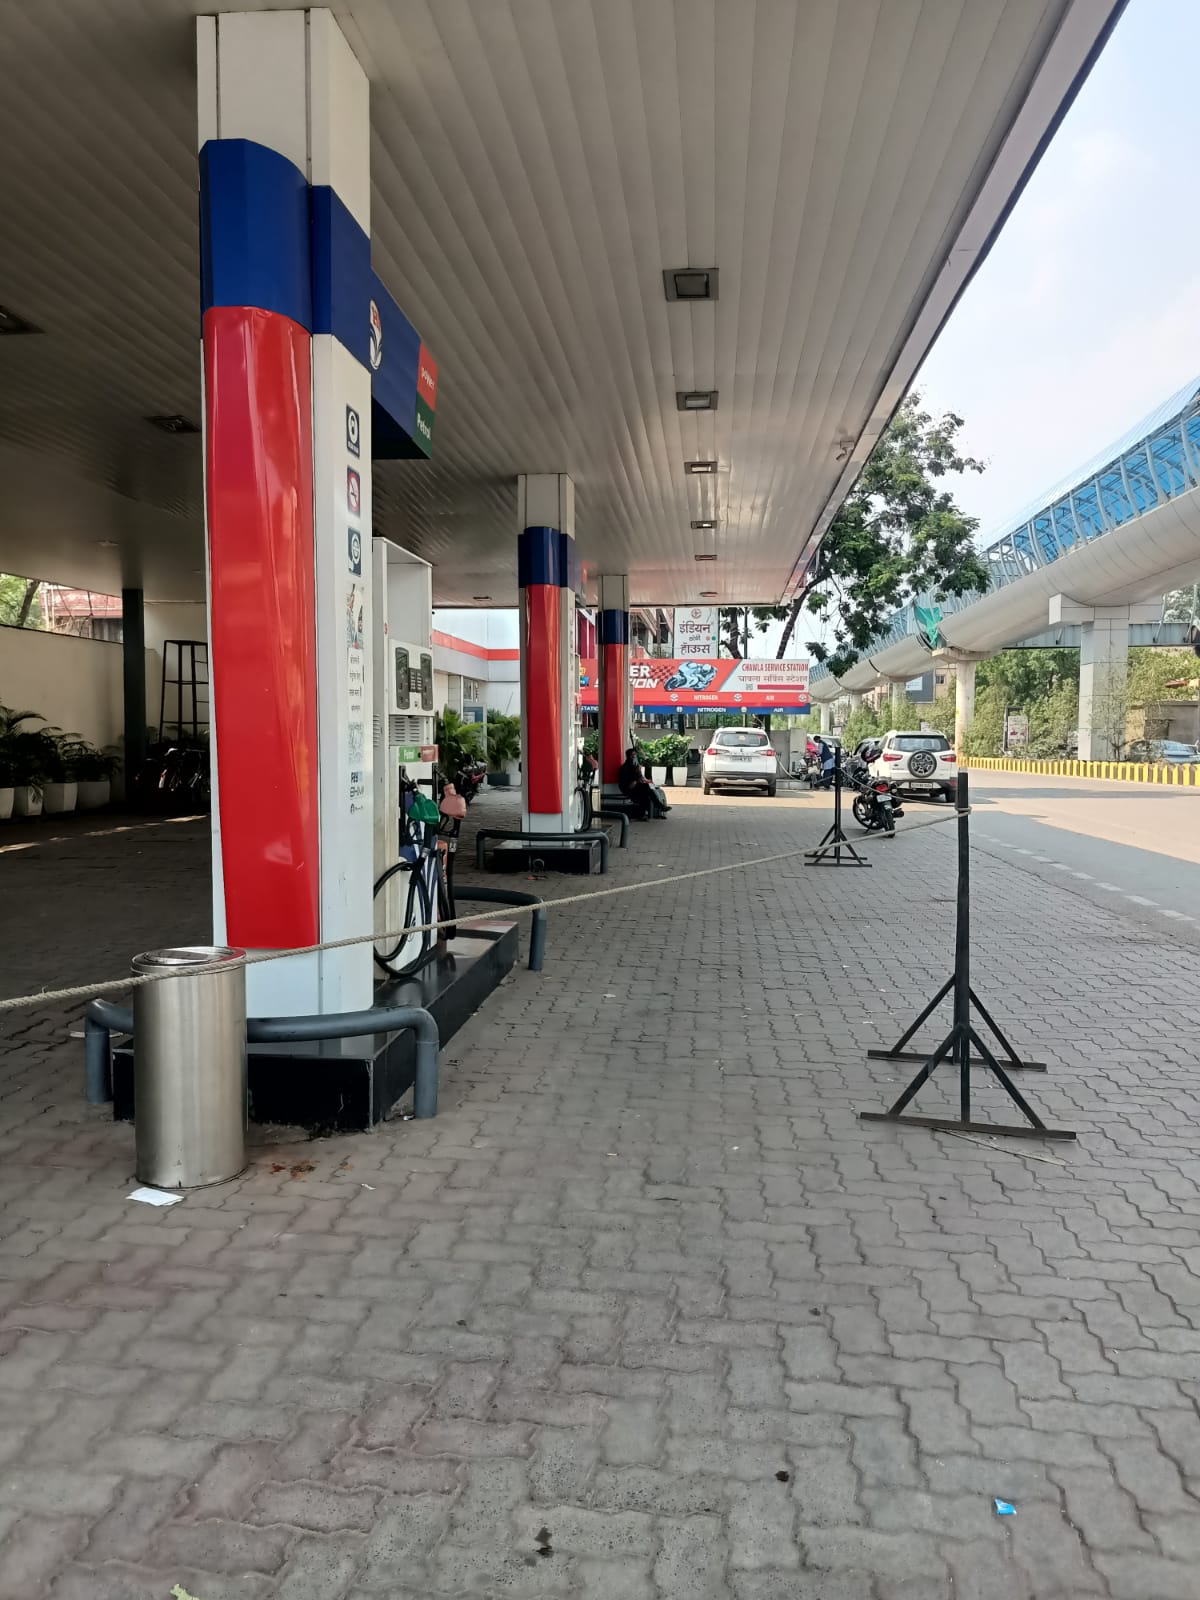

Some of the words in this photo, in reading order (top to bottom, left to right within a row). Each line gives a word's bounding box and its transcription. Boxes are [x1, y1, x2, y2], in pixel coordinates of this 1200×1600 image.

[417, 412, 431, 440] Petrol
[679, 620, 711, 634] इंडियन
[741, 663, 764, 672] CHAWLA
[764, 663, 785, 672] SERVICE
[785, 663, 809, 672] STATION
